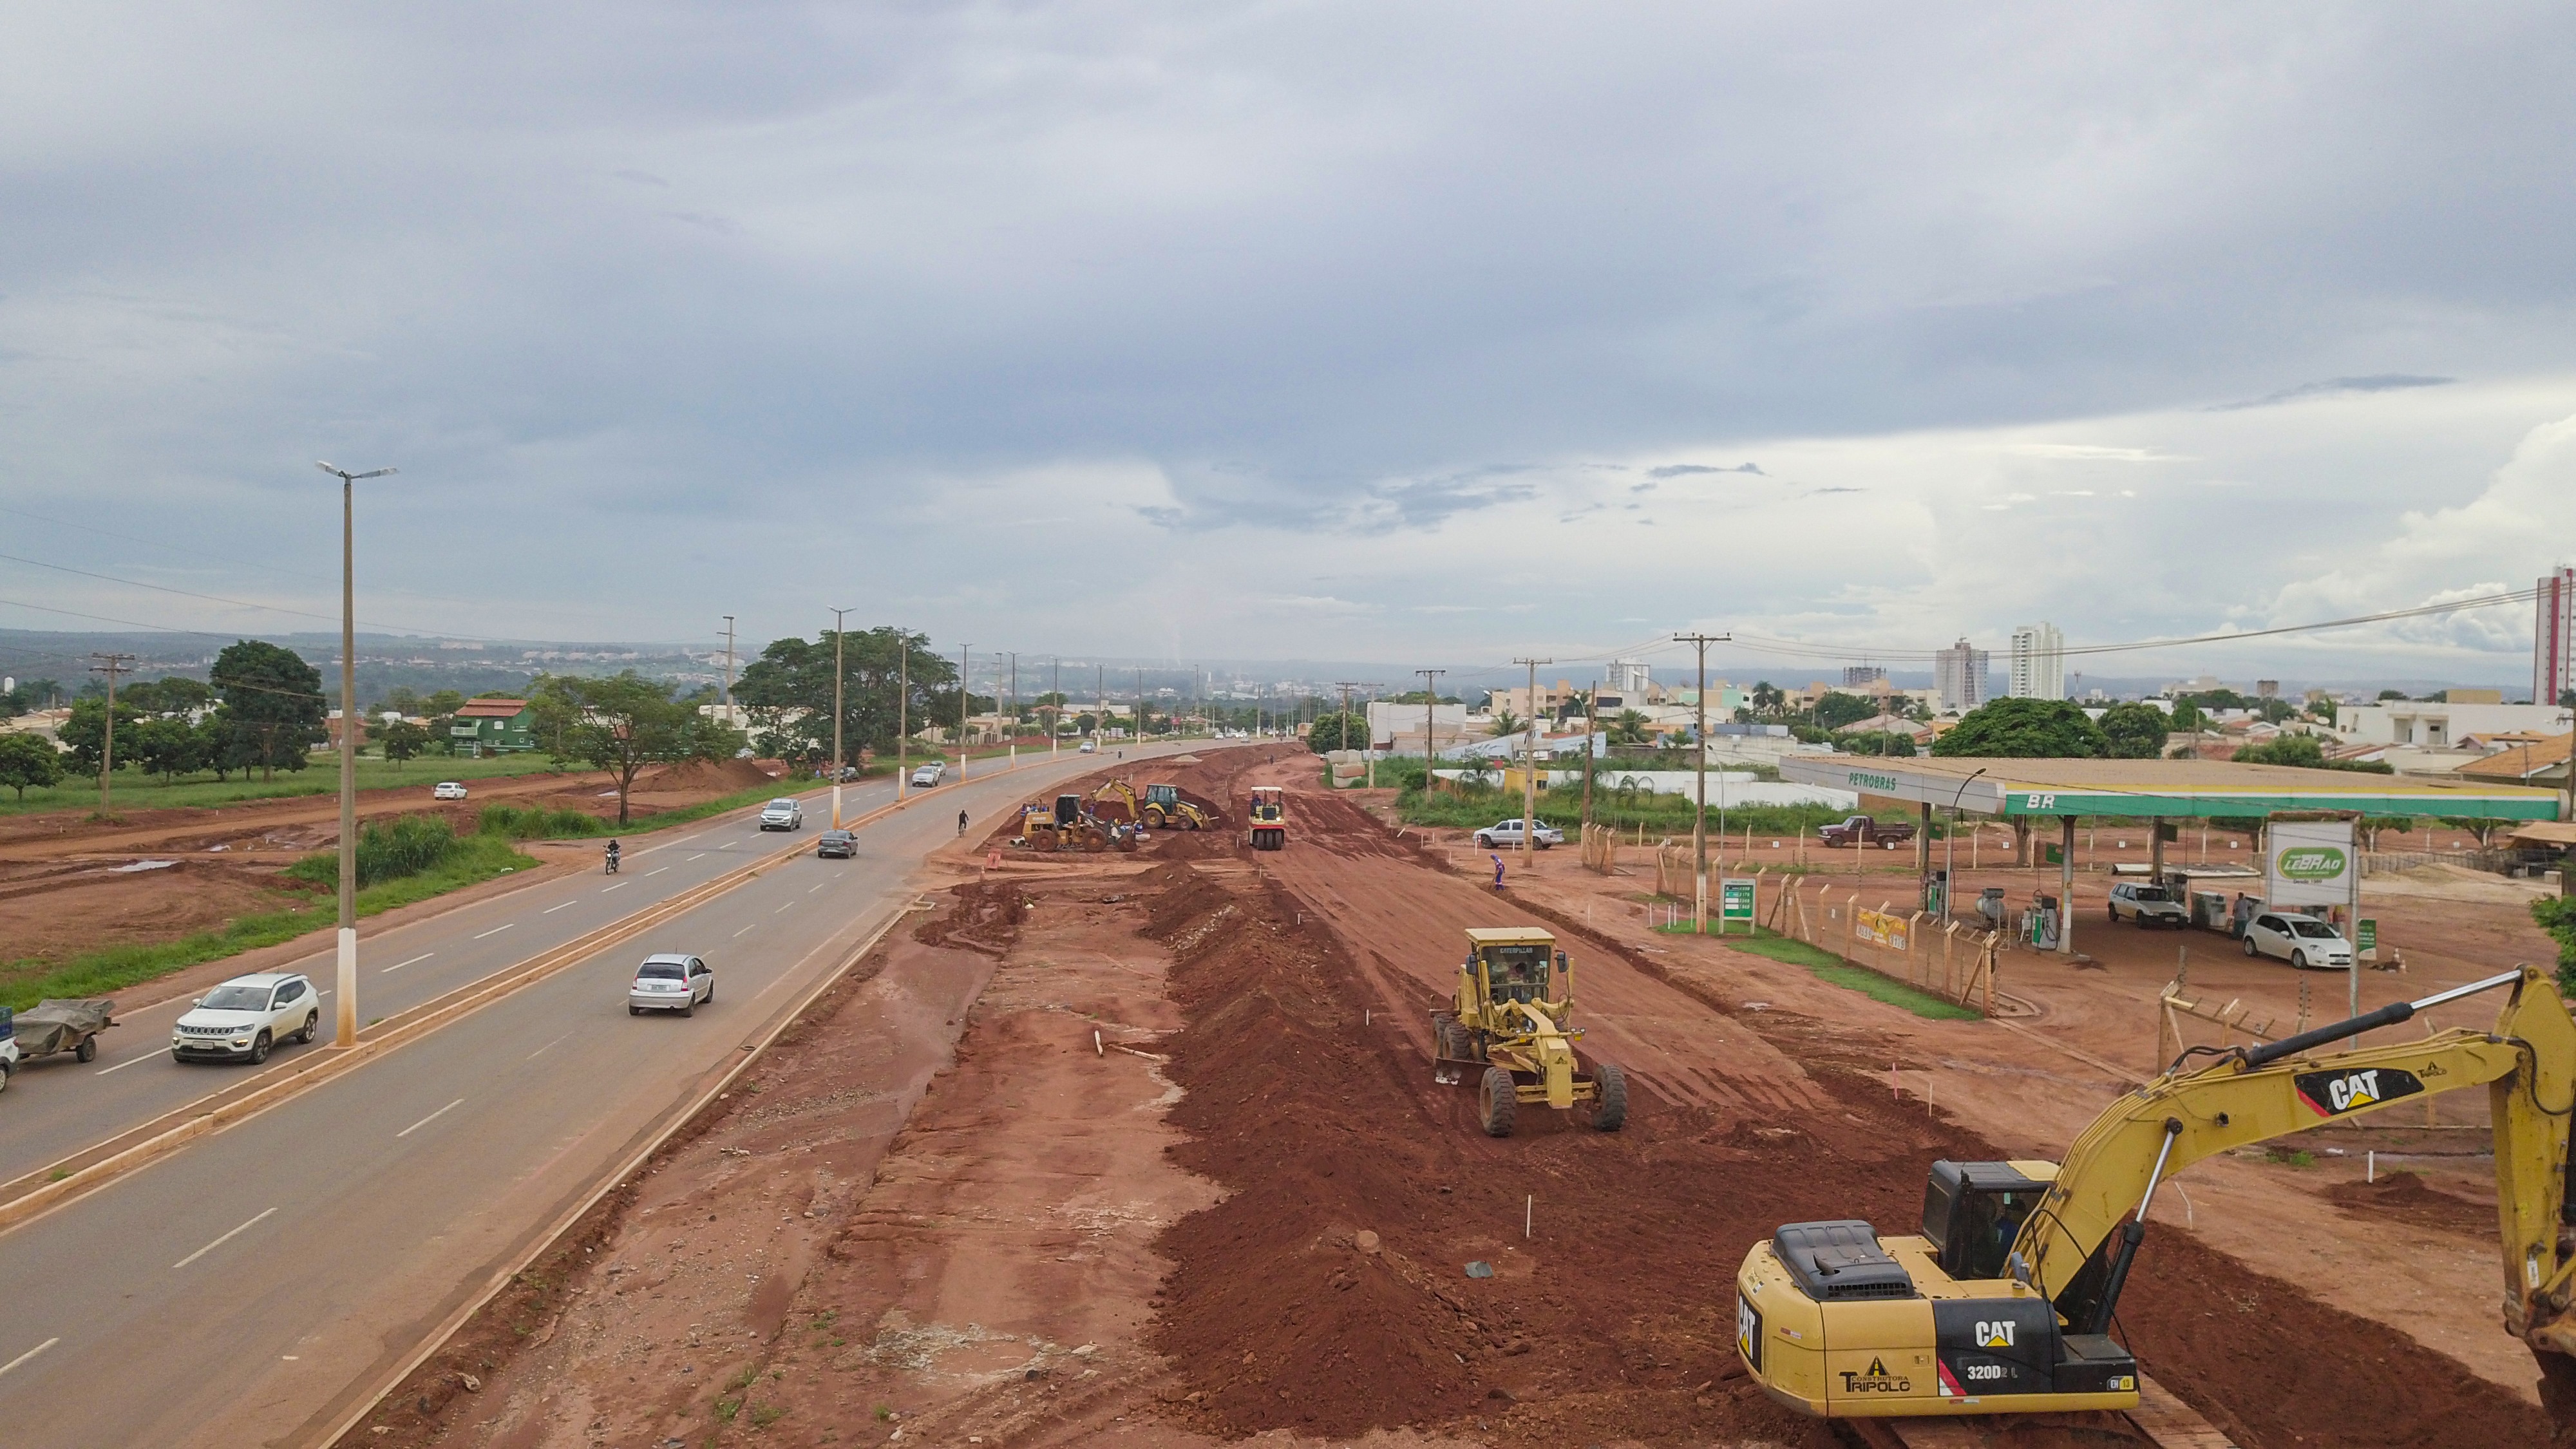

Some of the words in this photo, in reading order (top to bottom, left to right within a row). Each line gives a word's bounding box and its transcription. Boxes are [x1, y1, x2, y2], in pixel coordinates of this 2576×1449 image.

[1848, 772, 1896, 791] PETROBRAS
[2026, 794, 2055, 809] BR
[2329, 1070, 2380, 1110] CAT
[1739, 1295, 1756, 1359] CAT
[1975, 1321, 2016, 1347] CAT
[2123, 1379, 2130, 1388] 13
